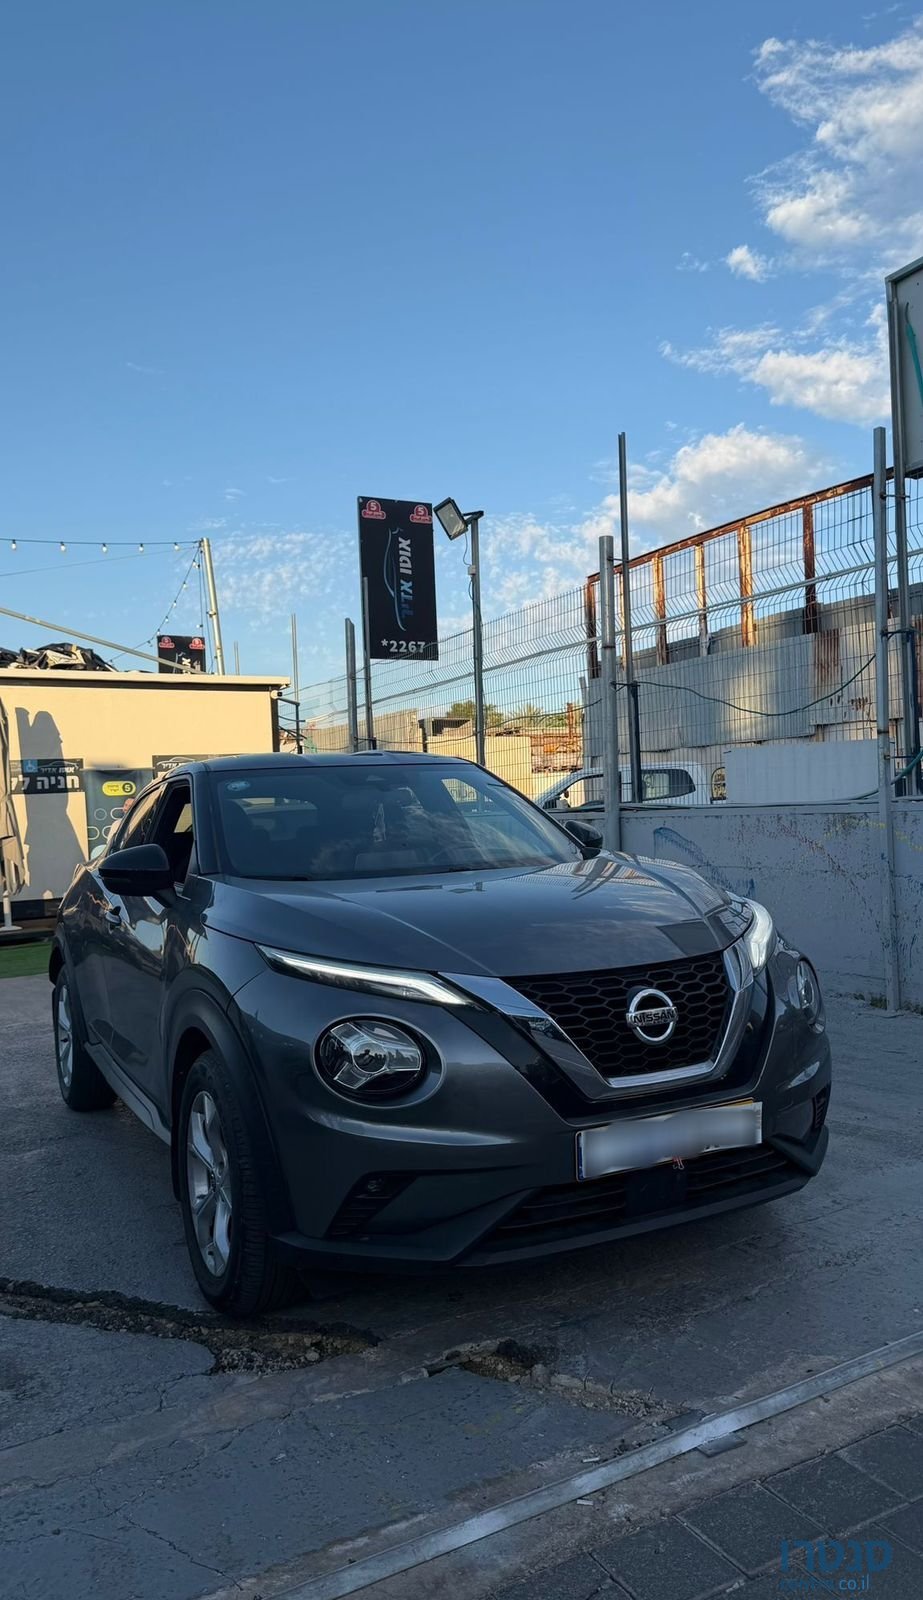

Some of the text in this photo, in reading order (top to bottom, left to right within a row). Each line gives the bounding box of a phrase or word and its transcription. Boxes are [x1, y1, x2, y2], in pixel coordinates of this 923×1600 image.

[370, 502, 377, 511] 5
[418, 506, 425, 515] 5
[399, 537, 412, 575] אוטו
[36, 776, 80, 790] חניה
[633, 1009, 676, 1024] NISSAN
